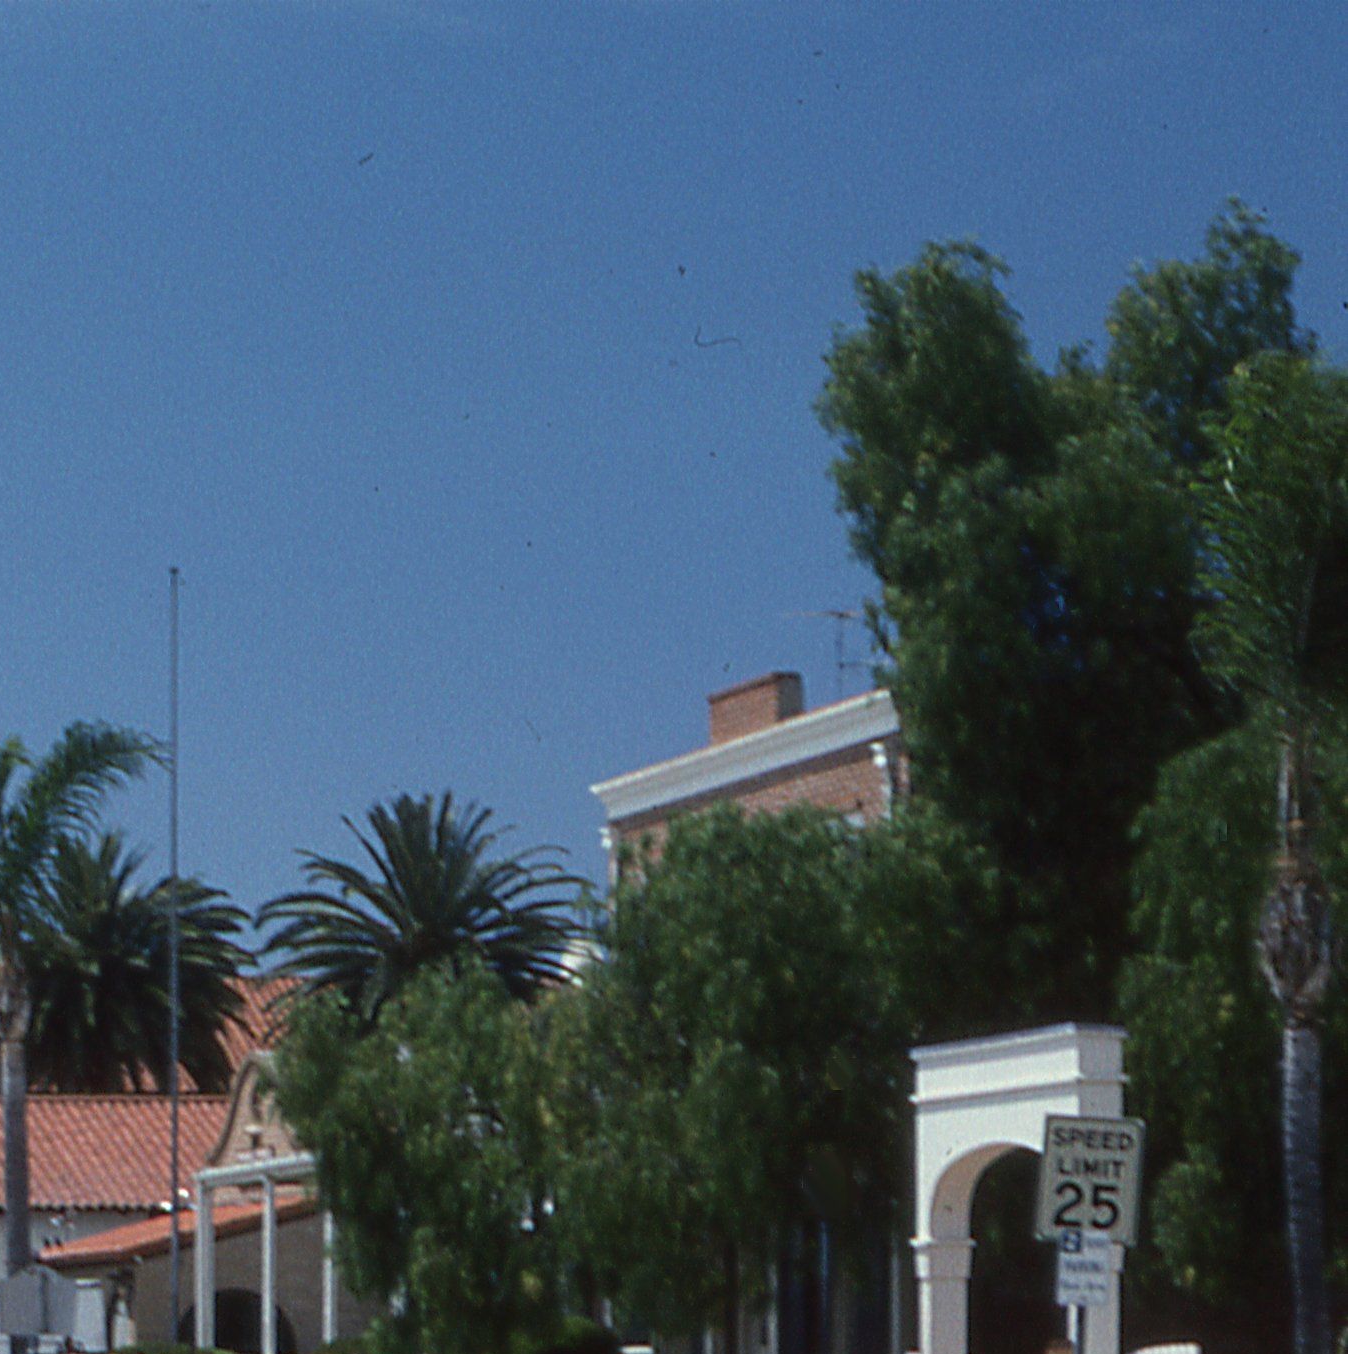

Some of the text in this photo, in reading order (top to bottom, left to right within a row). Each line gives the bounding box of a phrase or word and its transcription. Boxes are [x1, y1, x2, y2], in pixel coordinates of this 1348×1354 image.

[1052, 1126, 1134, 1150] SPEED
[1056, 1157, 1125, 1178] LIMIT
[1053, 1180, 1119, 1229] 25
